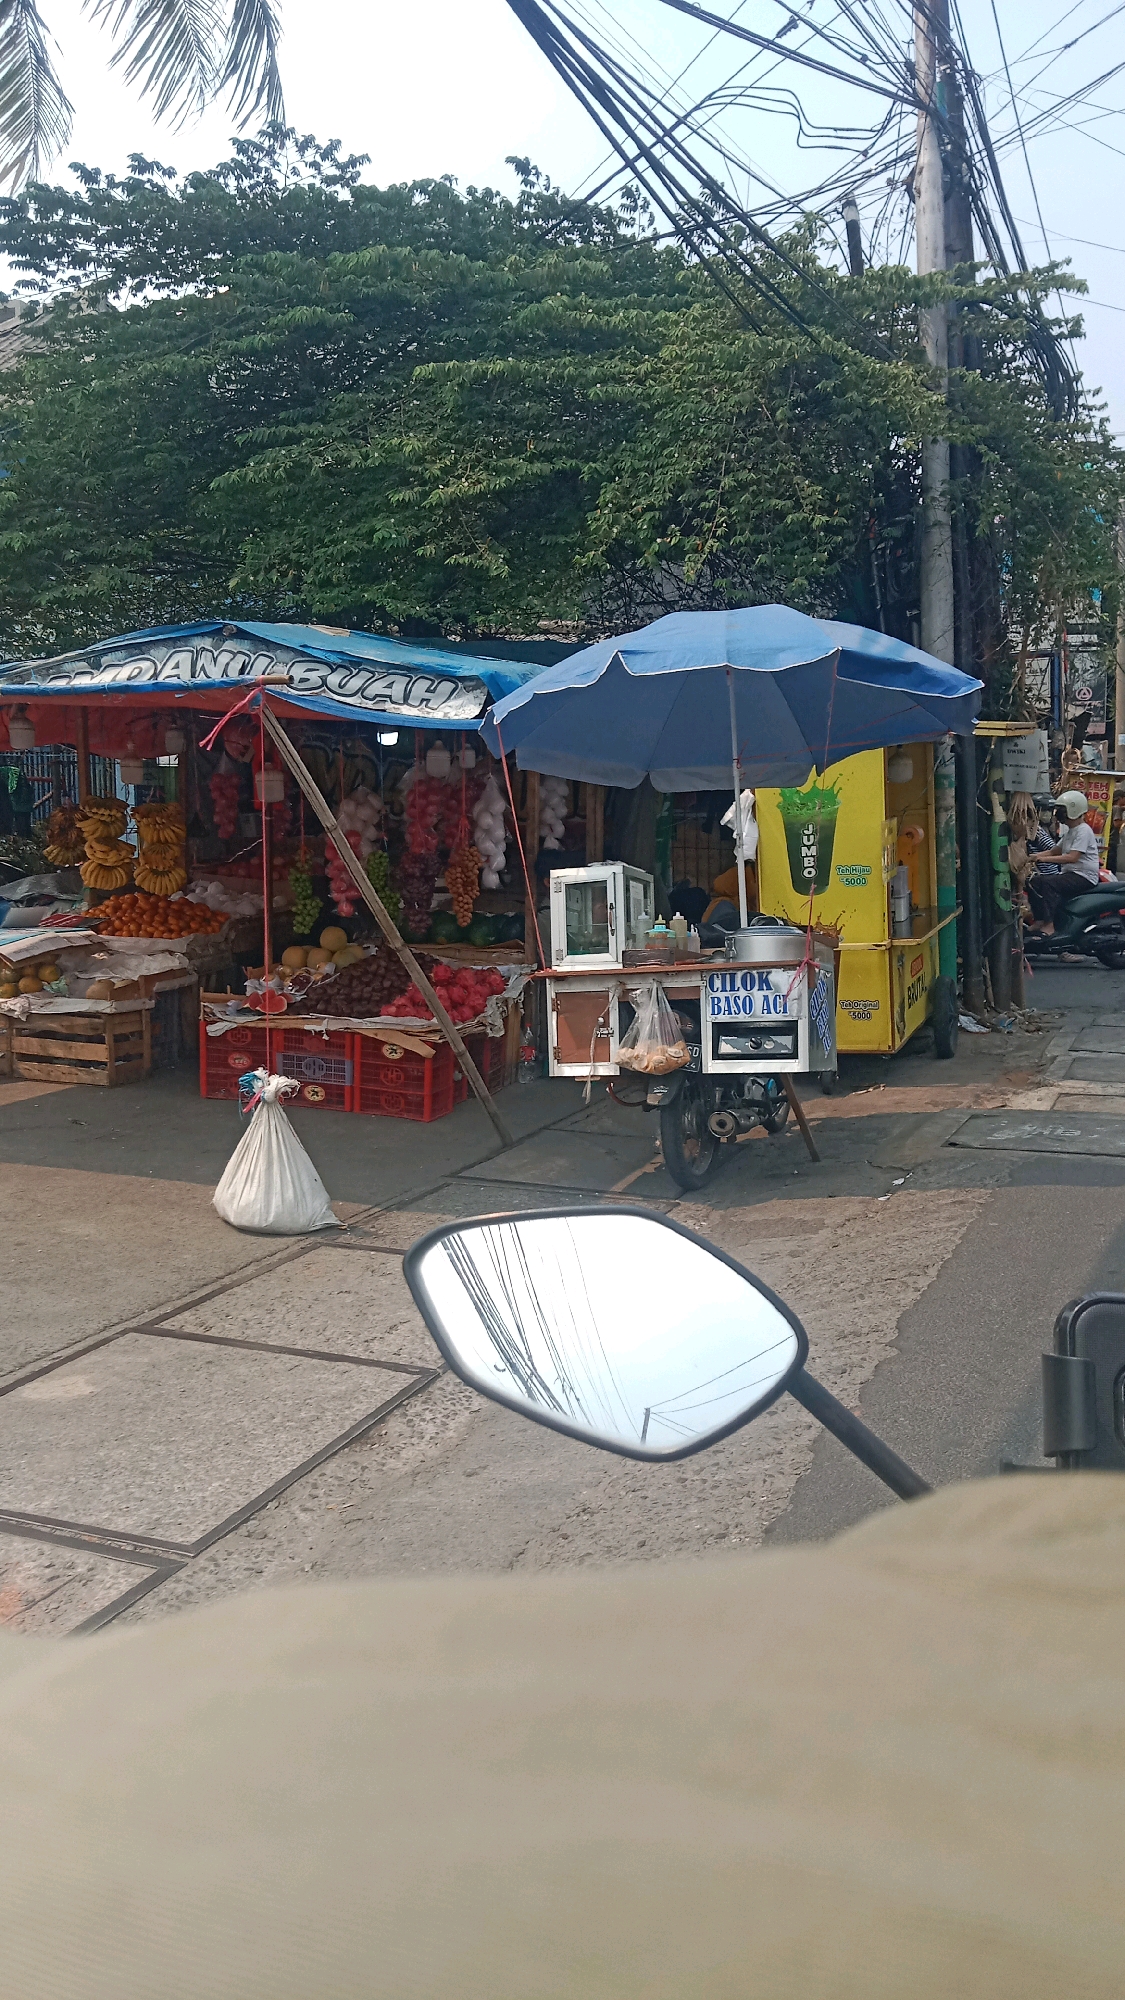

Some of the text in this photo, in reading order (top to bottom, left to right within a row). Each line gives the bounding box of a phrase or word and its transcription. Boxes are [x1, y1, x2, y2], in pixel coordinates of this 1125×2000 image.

[285, 657, 461, 711] BUAH
[800, 823, 817, 878] JUMBO
[836, 865, 871, 875] Teh Hijau
[708, 971, 773, 993] CILOK
[710, 994, 789, 1016] BASO ACI
[853, 1001, 878, 1009] Original
